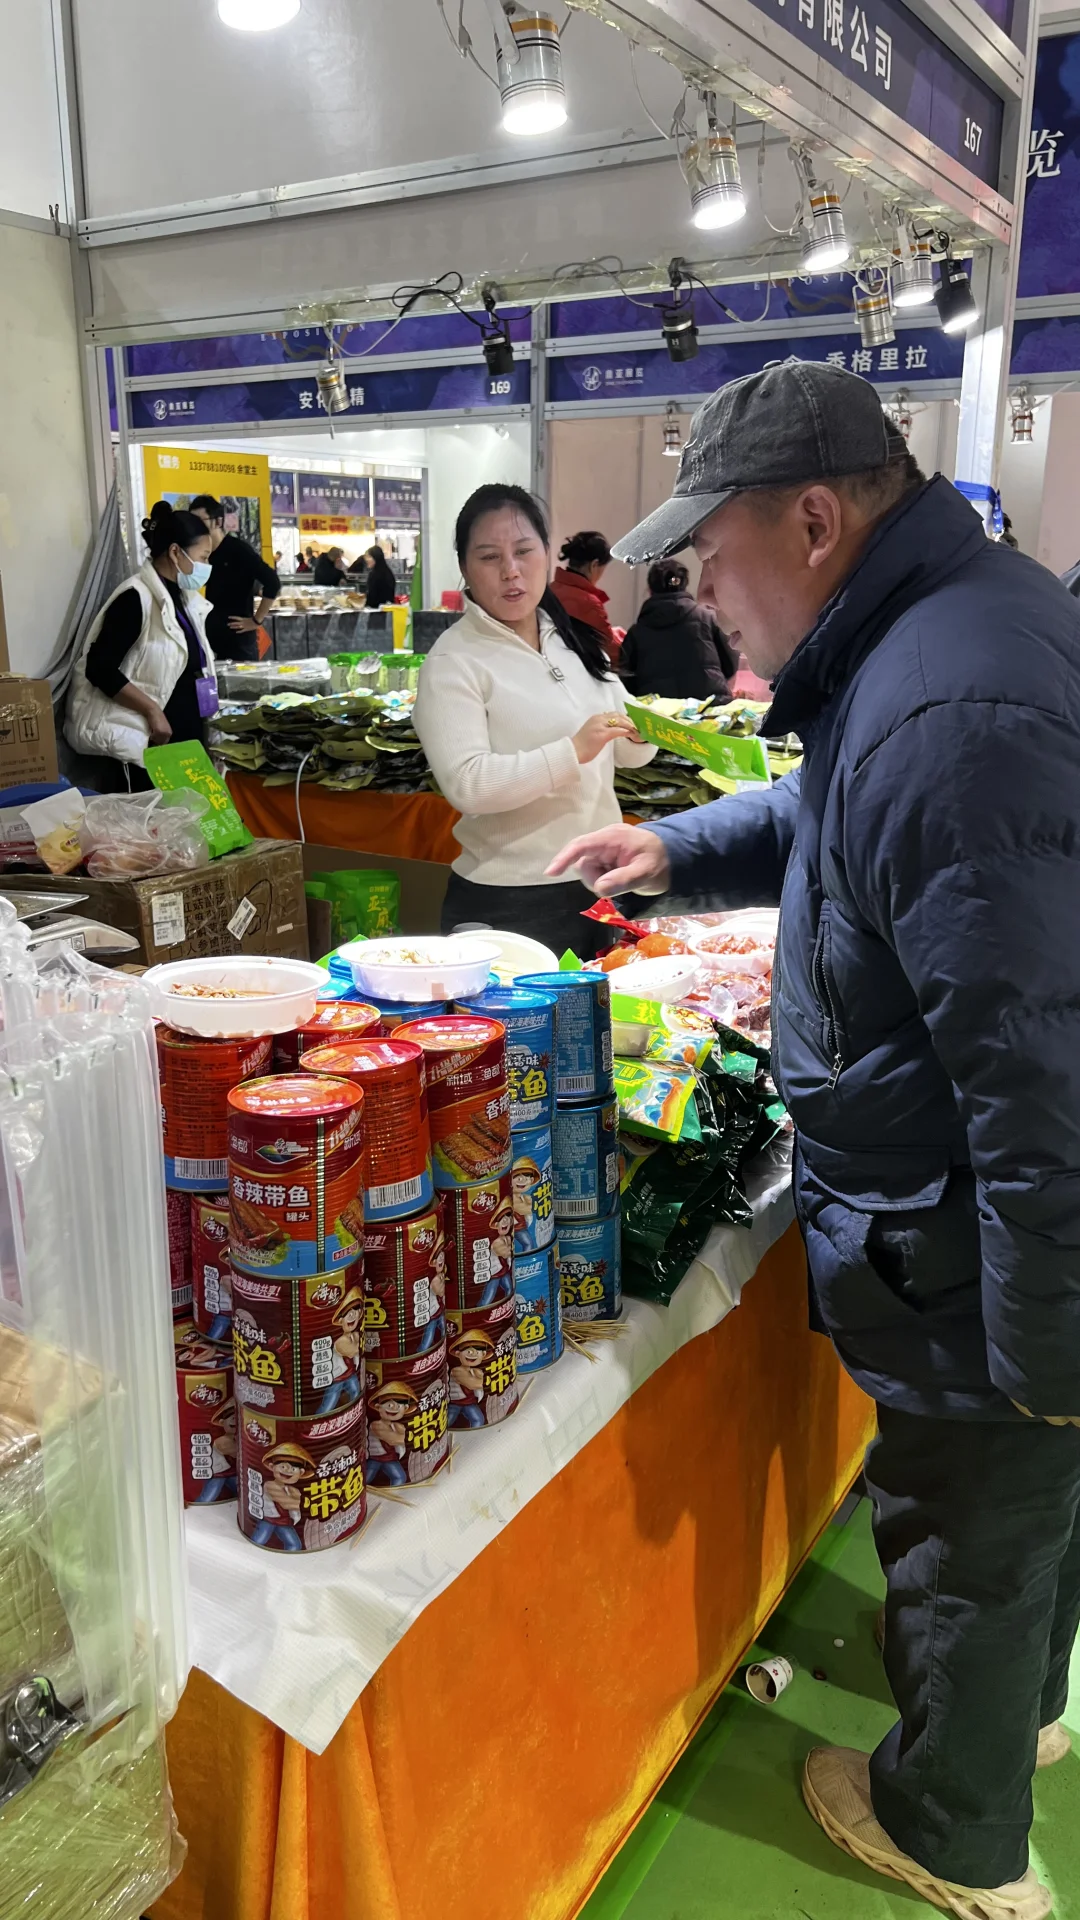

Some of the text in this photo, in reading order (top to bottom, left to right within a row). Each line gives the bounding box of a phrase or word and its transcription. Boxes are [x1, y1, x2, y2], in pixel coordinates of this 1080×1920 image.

[964, 117, 983, 156] 167
[825, 345, 928, 373] 香格里拉
[489, 380, 511, 395] 169
[232, 1175, 311, 1208] 香辣带鱼
[285, 1211, 310, 1222] 罐头
[316, 1450, 358, 1478] 香辣味
[304, 1464, 364, 1519] 带鱼
